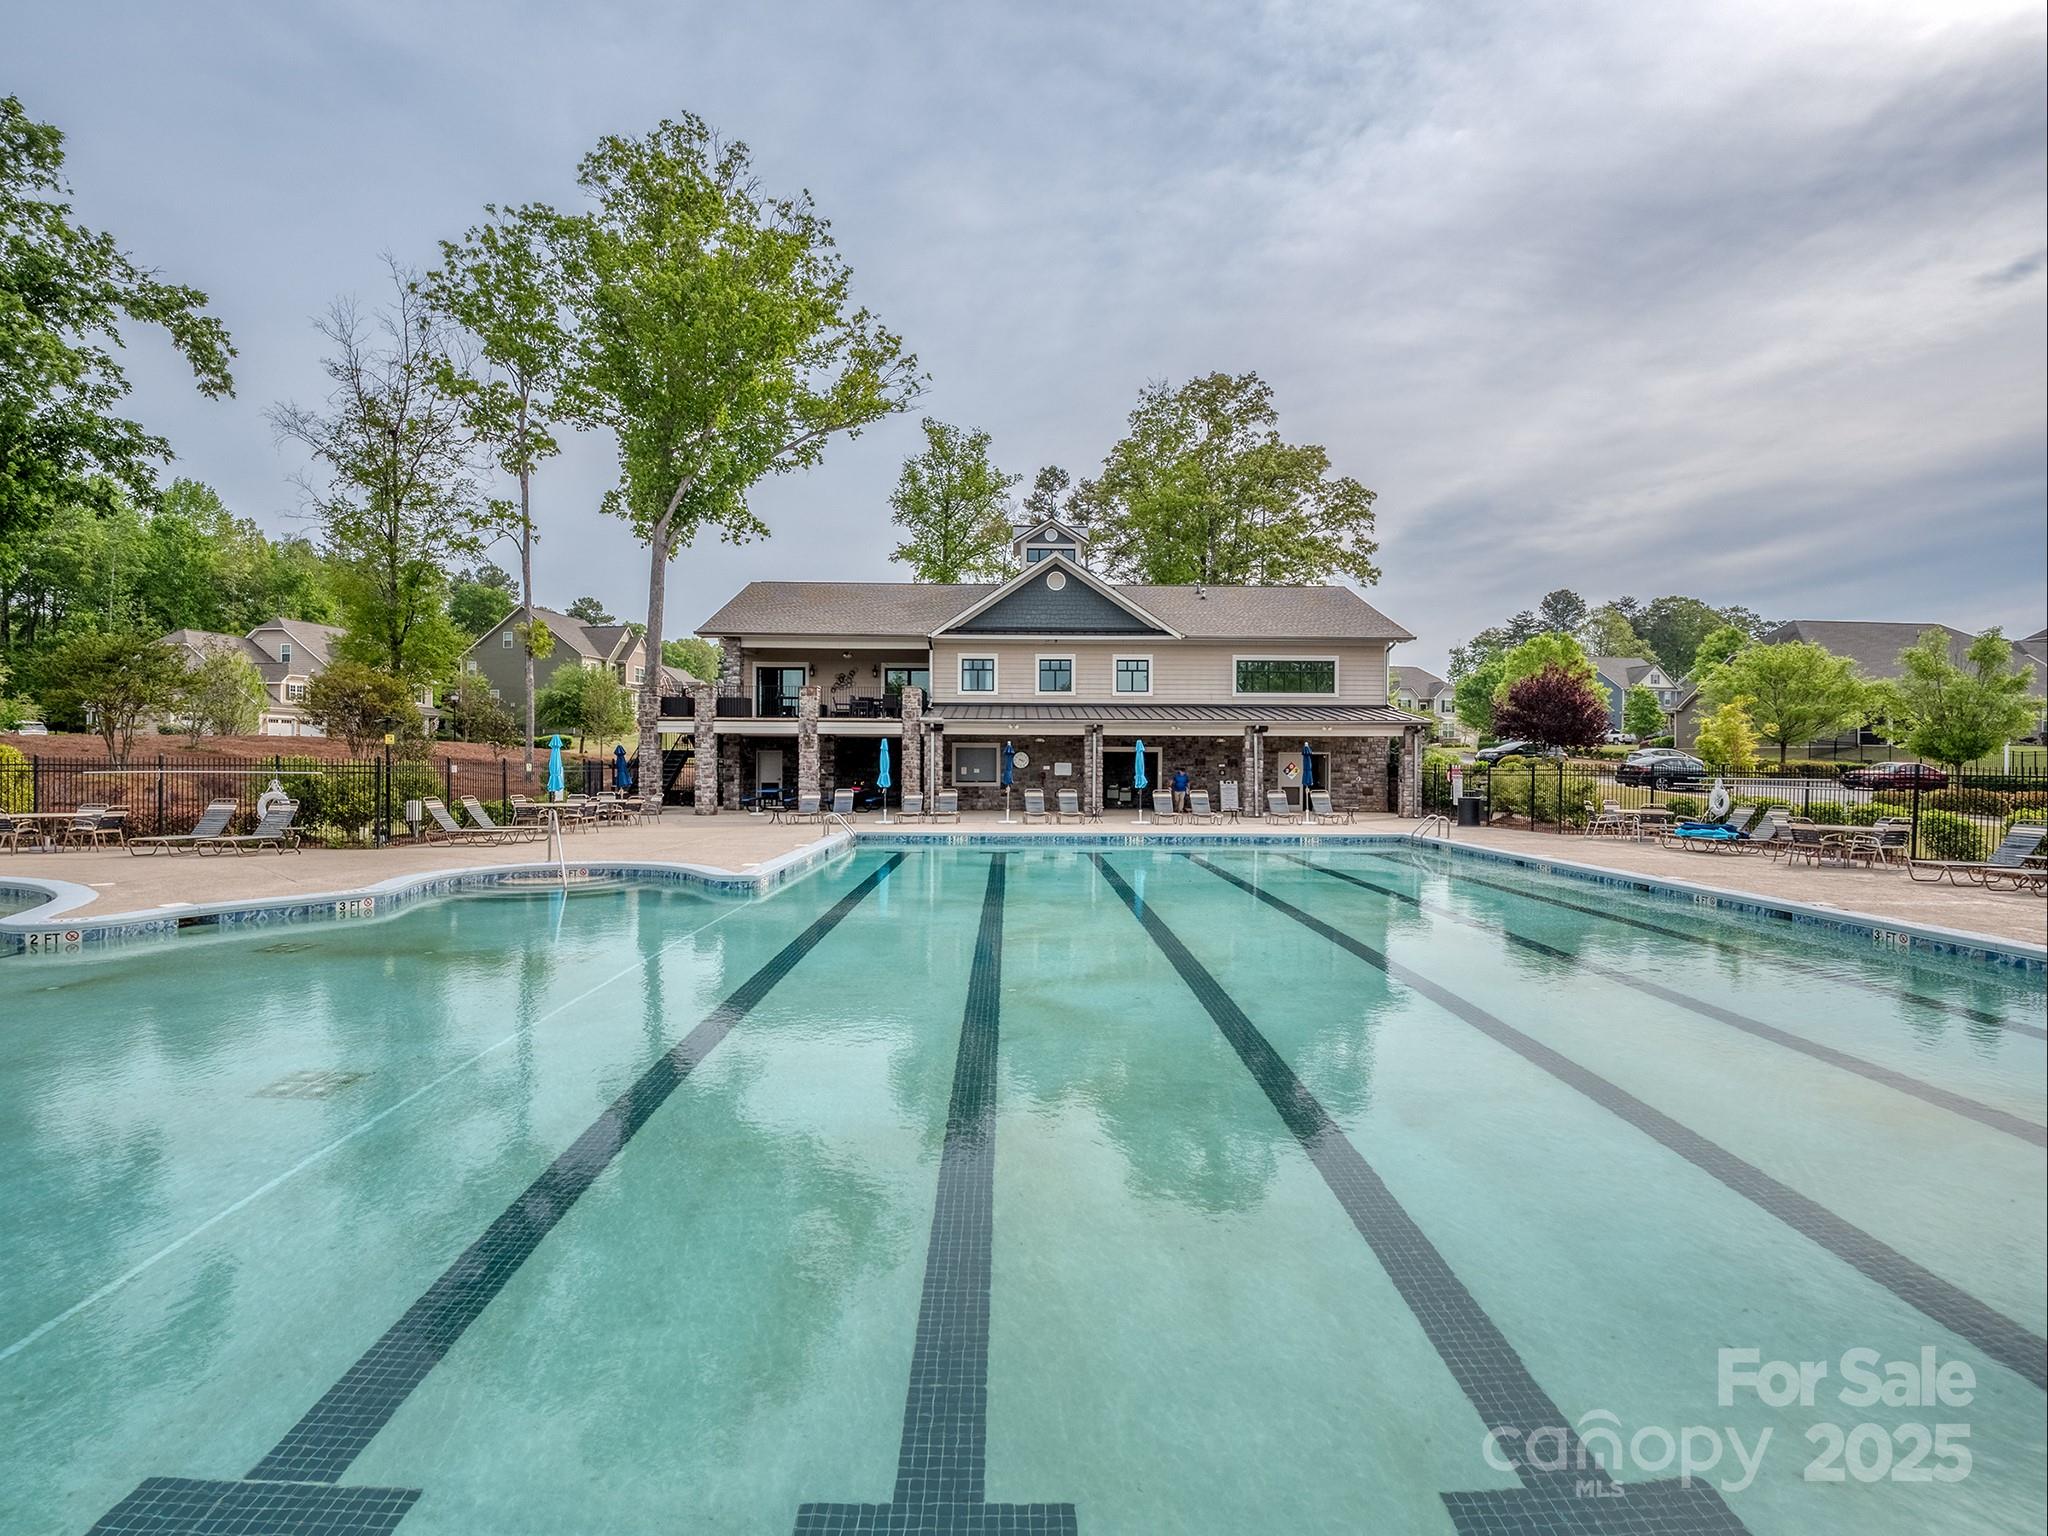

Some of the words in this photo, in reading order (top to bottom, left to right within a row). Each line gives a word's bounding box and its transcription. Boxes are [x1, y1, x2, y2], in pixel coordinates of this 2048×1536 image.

[568, 869, 577, 877] FT
[339, 901, 346, 911] 3
[350, 900, 361, 911] FT
[30, 934, 38, 945] 2
[44, 933, 60, 945] FT
[1886, 931, 1896, 942] FT
